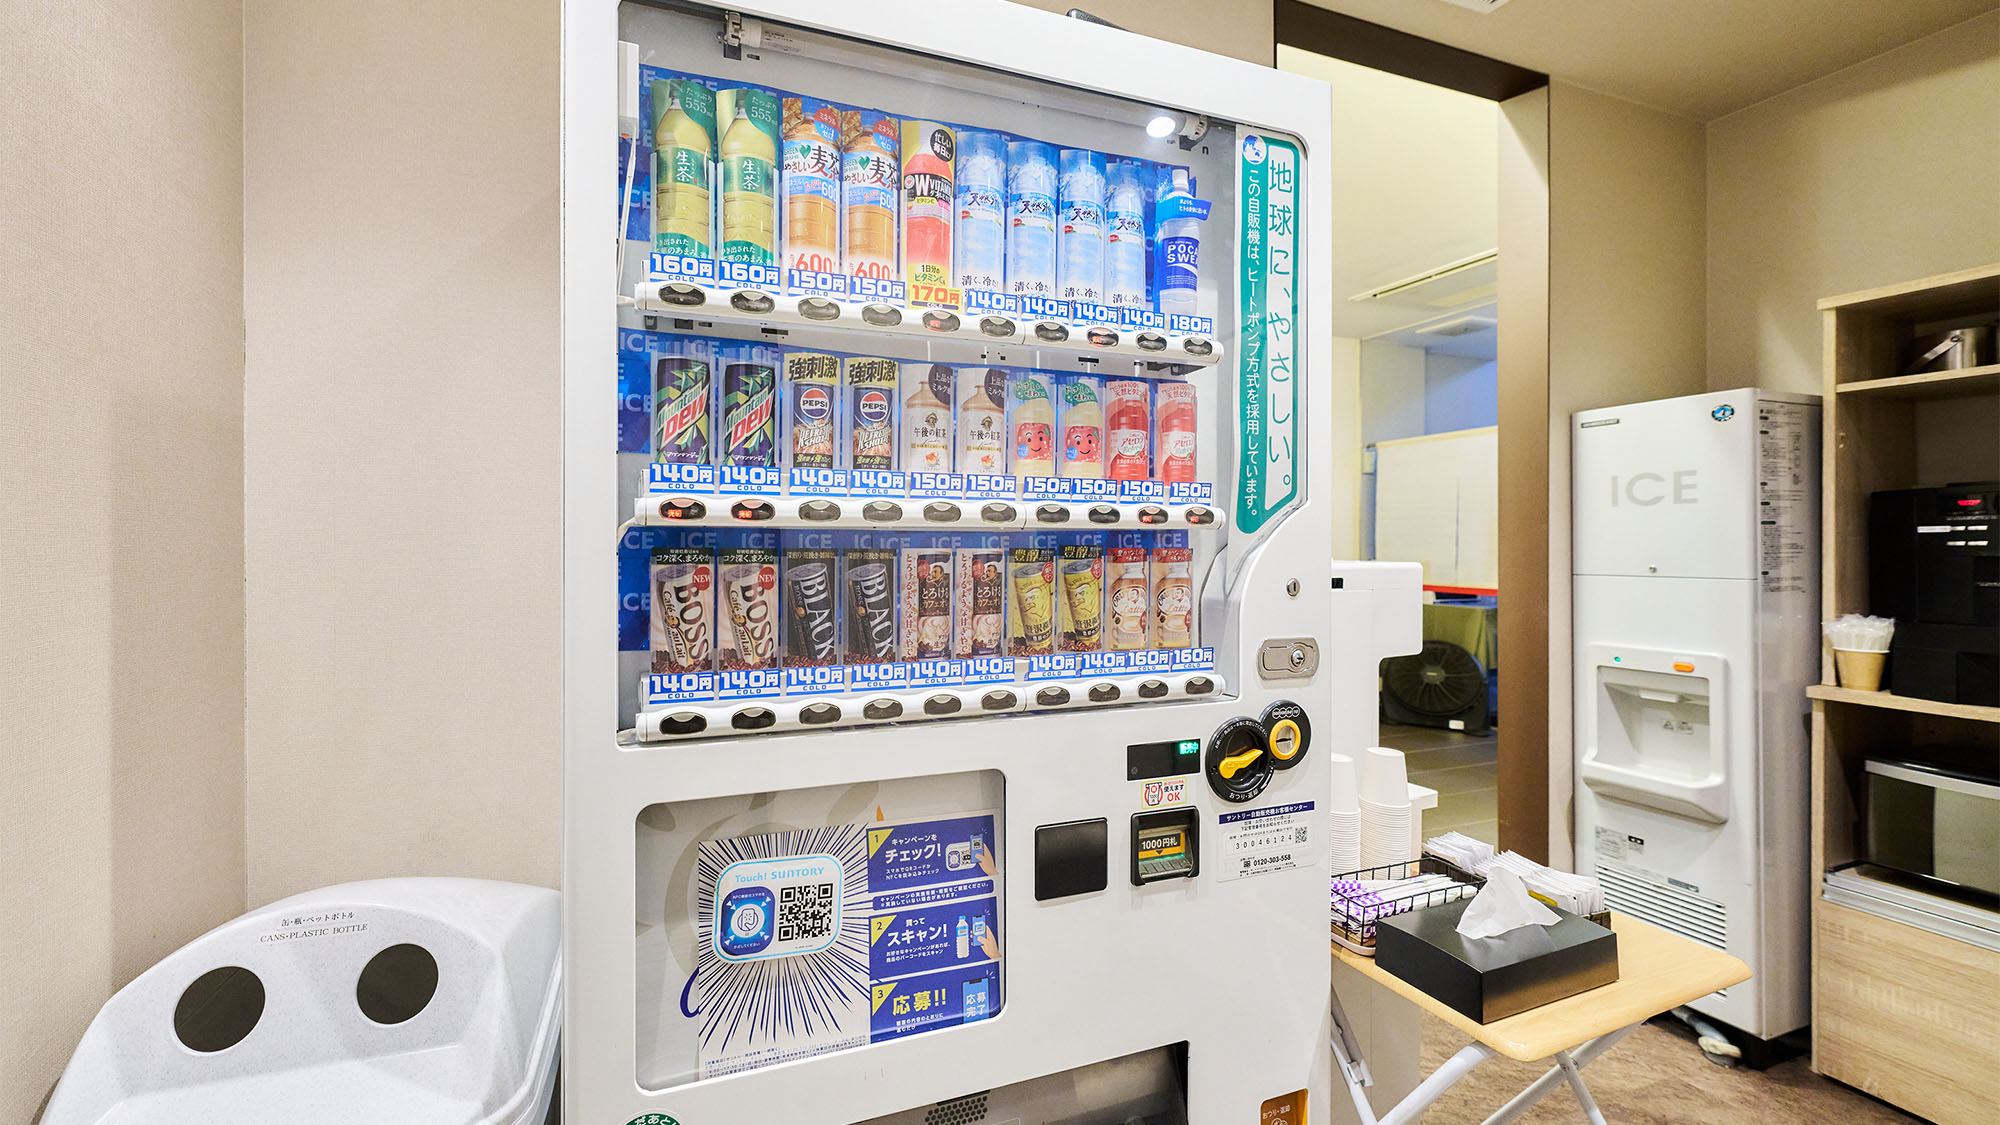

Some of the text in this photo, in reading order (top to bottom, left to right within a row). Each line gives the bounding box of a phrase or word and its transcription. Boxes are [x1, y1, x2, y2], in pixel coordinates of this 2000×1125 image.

[686, 87, 713, 102] たっぷり
[751, 96, 777, 111] たっぷり
[676, 151, 695, 182] 生茶
[743, 159, 760, 190] 生茶
[914, 174, 930, 196] W
[1020, 200, 1052, 217] 天然水
[652, 254, 713, 277] 160円
[1167, 253, 1198, 265] SWE
[721, 262, 778, 284] 160円
[791, 270, 846, 291] 150円
[853, 276, 904, 298] 150円
[912, 285, 960, 304] 170円
[969, 290, 1016, 311] 140円
[1024, 297, 1068, 316] 140円
[1076, 303, 1118, 322] 140円
[1123, 309, 1164, 327] 140円
[1172, 315, 1211, 333] 180円
[1267, 160, 1293, 486] 地球に、やさしい。
[620, 332, 658, 352] ICE
[1244, 169, 1261, 516] この自販機は、ヒートポンプ方式を採用しています。
[789, 356, 838, 381] 強刺激
[849, 360, 896, 385] 強刺激
[802, 399, 828, 408] PEPSI
[862, 403, 887, 411] PEPSI
[652, 464, 712, 482] 140円
[722, 466, 779, 484] 140円
[792, 469, 846, 486] 140円
[853, 471, 904, 488] 140円
[913, 473, 962, 490] 150円
[969, 475, 1015, 492] 150円
[1026, 478, 1070, 493] 150円
[1074, 479, 1117, 495] 150円
[1123, 481, 1163, 496] 150円
[1172, 483, 1211, 497] 150円
[1611, 470, 1698, 507] ICE
[741, 533, 776, 548] ICE
[798, 534, 833, 549] ICE
[1118, 534, 1142, 548] ICE
[1157, 533, 1182, 547] ICE
[693, 574, 712, 584] NEW
[758, 574, 776, 584] NEW
[674, 583, 709, 659] BOSS
[740, 583, 774, 658] BOSS
[800, 573, 835, 659] BLACK
[860, 573, 893, 658] BLACK
[1031, 655, 1074, 671] 140円
[1083, 652, 1126, 668] 140円
[1129, 651, 1170, 666] 160円
[1174, 649, 1213, 663] 160円
[853, 664, 905, 682] 140円
[913, 661, 961, 678] 140円
[967, 658, 1013, 674] 140円
[652, 674, 712, 692] 140円
[721, 671, 779, 689] 140円
[789, 667, 843, 685] 140円
[1163, 784, 1184, 792] 使えます
[1167, 792, 1181, 802] OK
[874, 834, 879, 843] 1
[891, 833, 937, 846] キャンペーンを
[1141, 836, 1178, 850] 1000円札
[885, 843, 941, 864] チェック!
[735, 872, 767, 883] Touch!
[333, 923, 368, 935] BOTTLE
[876, 921, 883, 930] 2
[905, 917, 926, 927] 買って
[887, 923, 947, 947] スキャン!
[877, 990, 884, 999] 3
[892, 988, 946, 1016] 応募!!
[966, 992, 986, 1005] 応募
[966, 1004, 986, 1018] 完了
